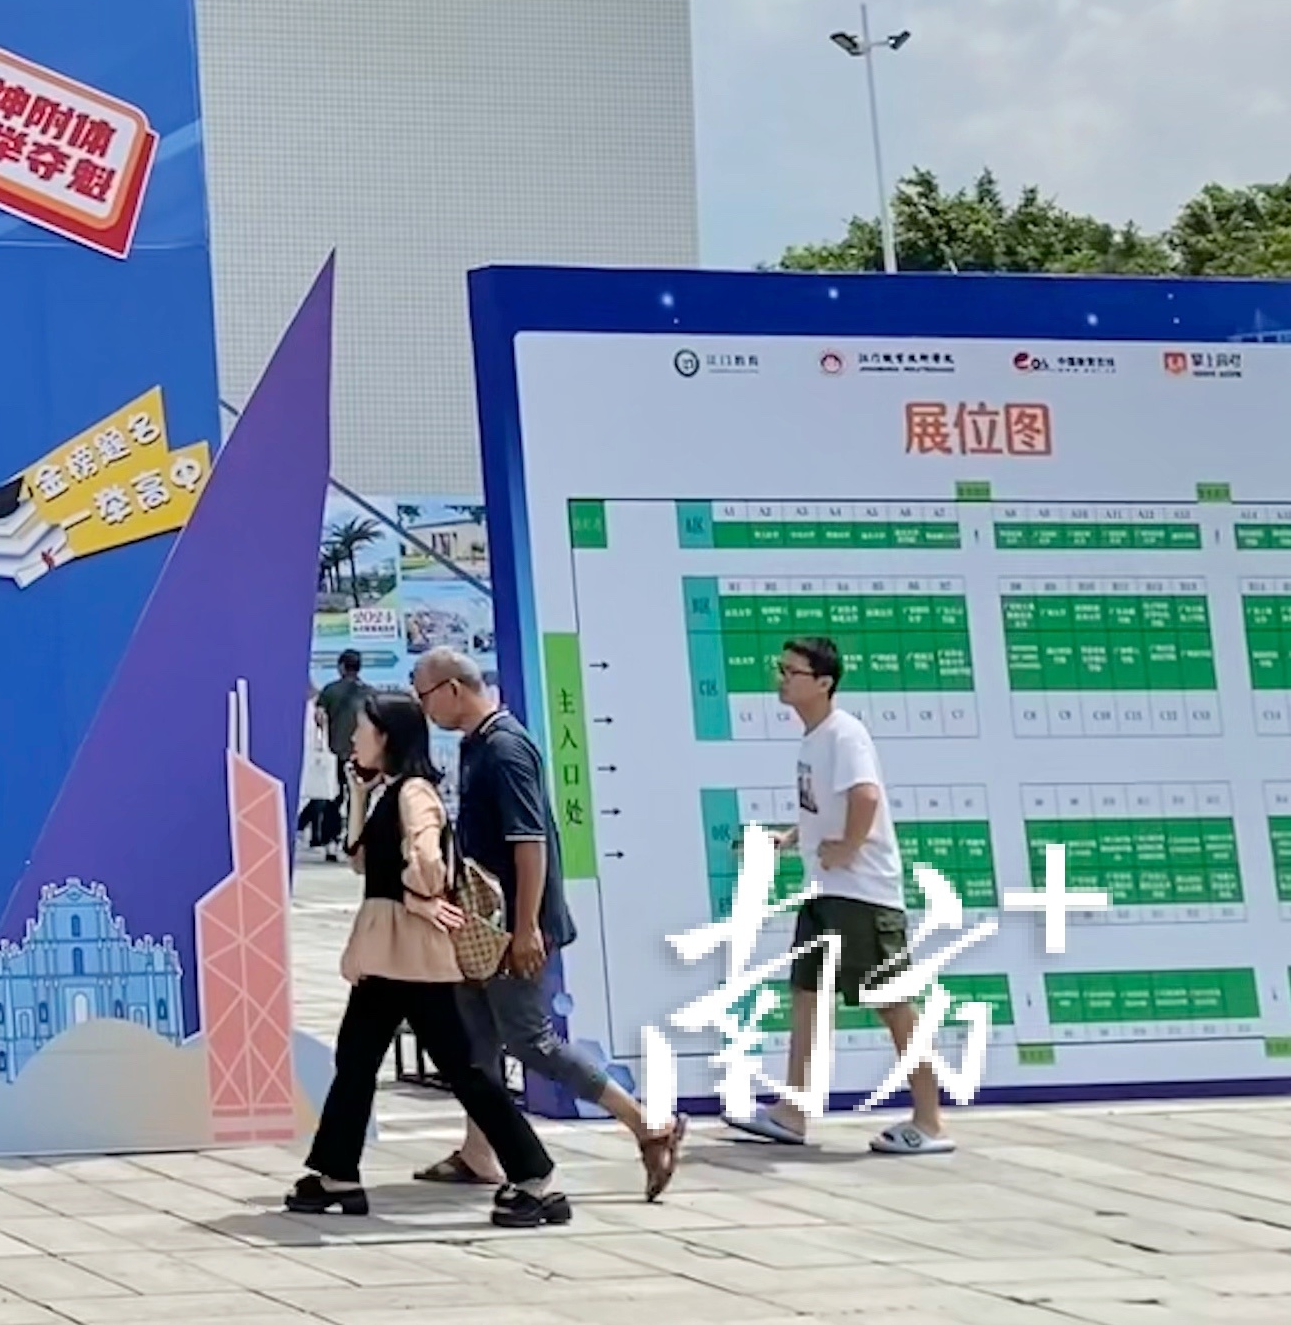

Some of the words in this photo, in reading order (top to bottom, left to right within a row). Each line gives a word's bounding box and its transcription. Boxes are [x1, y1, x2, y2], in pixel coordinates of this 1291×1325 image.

[34, 411, 161, 503] 金榜题名
[904, 401, 1052, 456] 展位图
[556, 687, 584, 825] 主入口处
